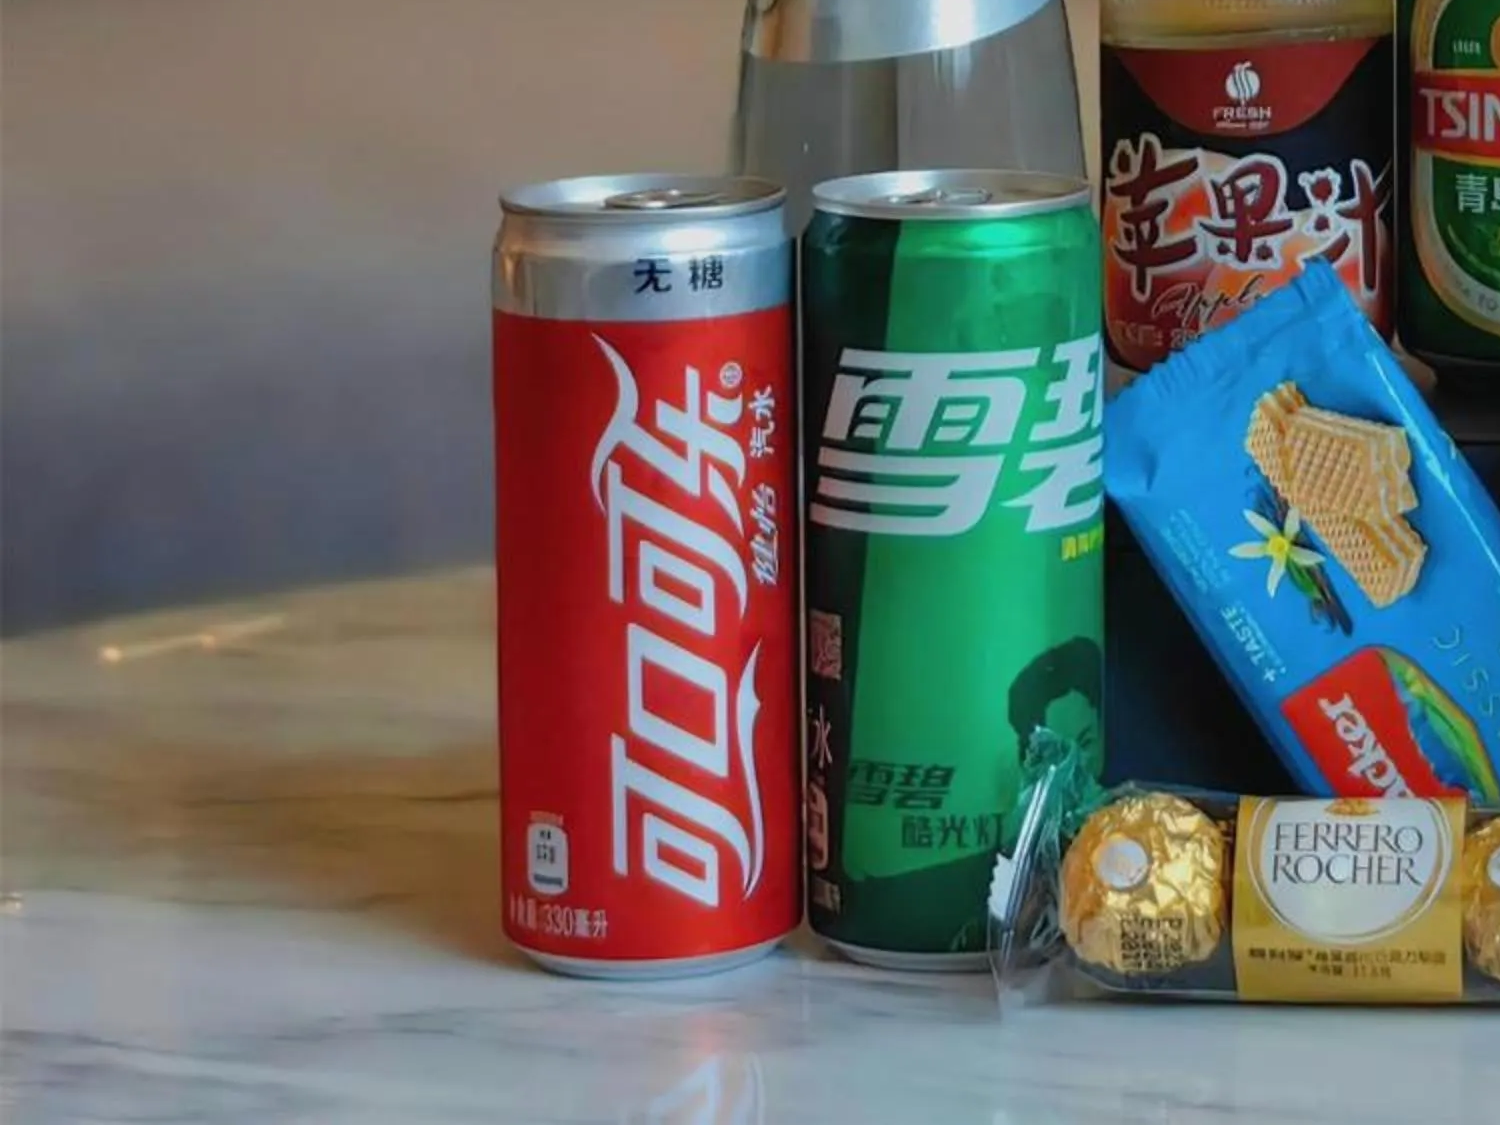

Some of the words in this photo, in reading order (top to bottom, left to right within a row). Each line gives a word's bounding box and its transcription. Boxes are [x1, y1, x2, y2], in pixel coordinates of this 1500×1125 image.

[1213, 106, 1272, 120] FRESH
[633, 255, 723, 293] 无糖
[748, 385, 777, 458] 汽水
[591, 332, 763, 908] 可口可乐
[1220, 605, 1266, 665] TASTE
[848, 758, 955, 810] 雪碧
[901, 812, 1006, 849] 酷光灯
[1274, 821, 1424, 854] FERRERO
[1272, 853, 1422, 886] ROCHER
